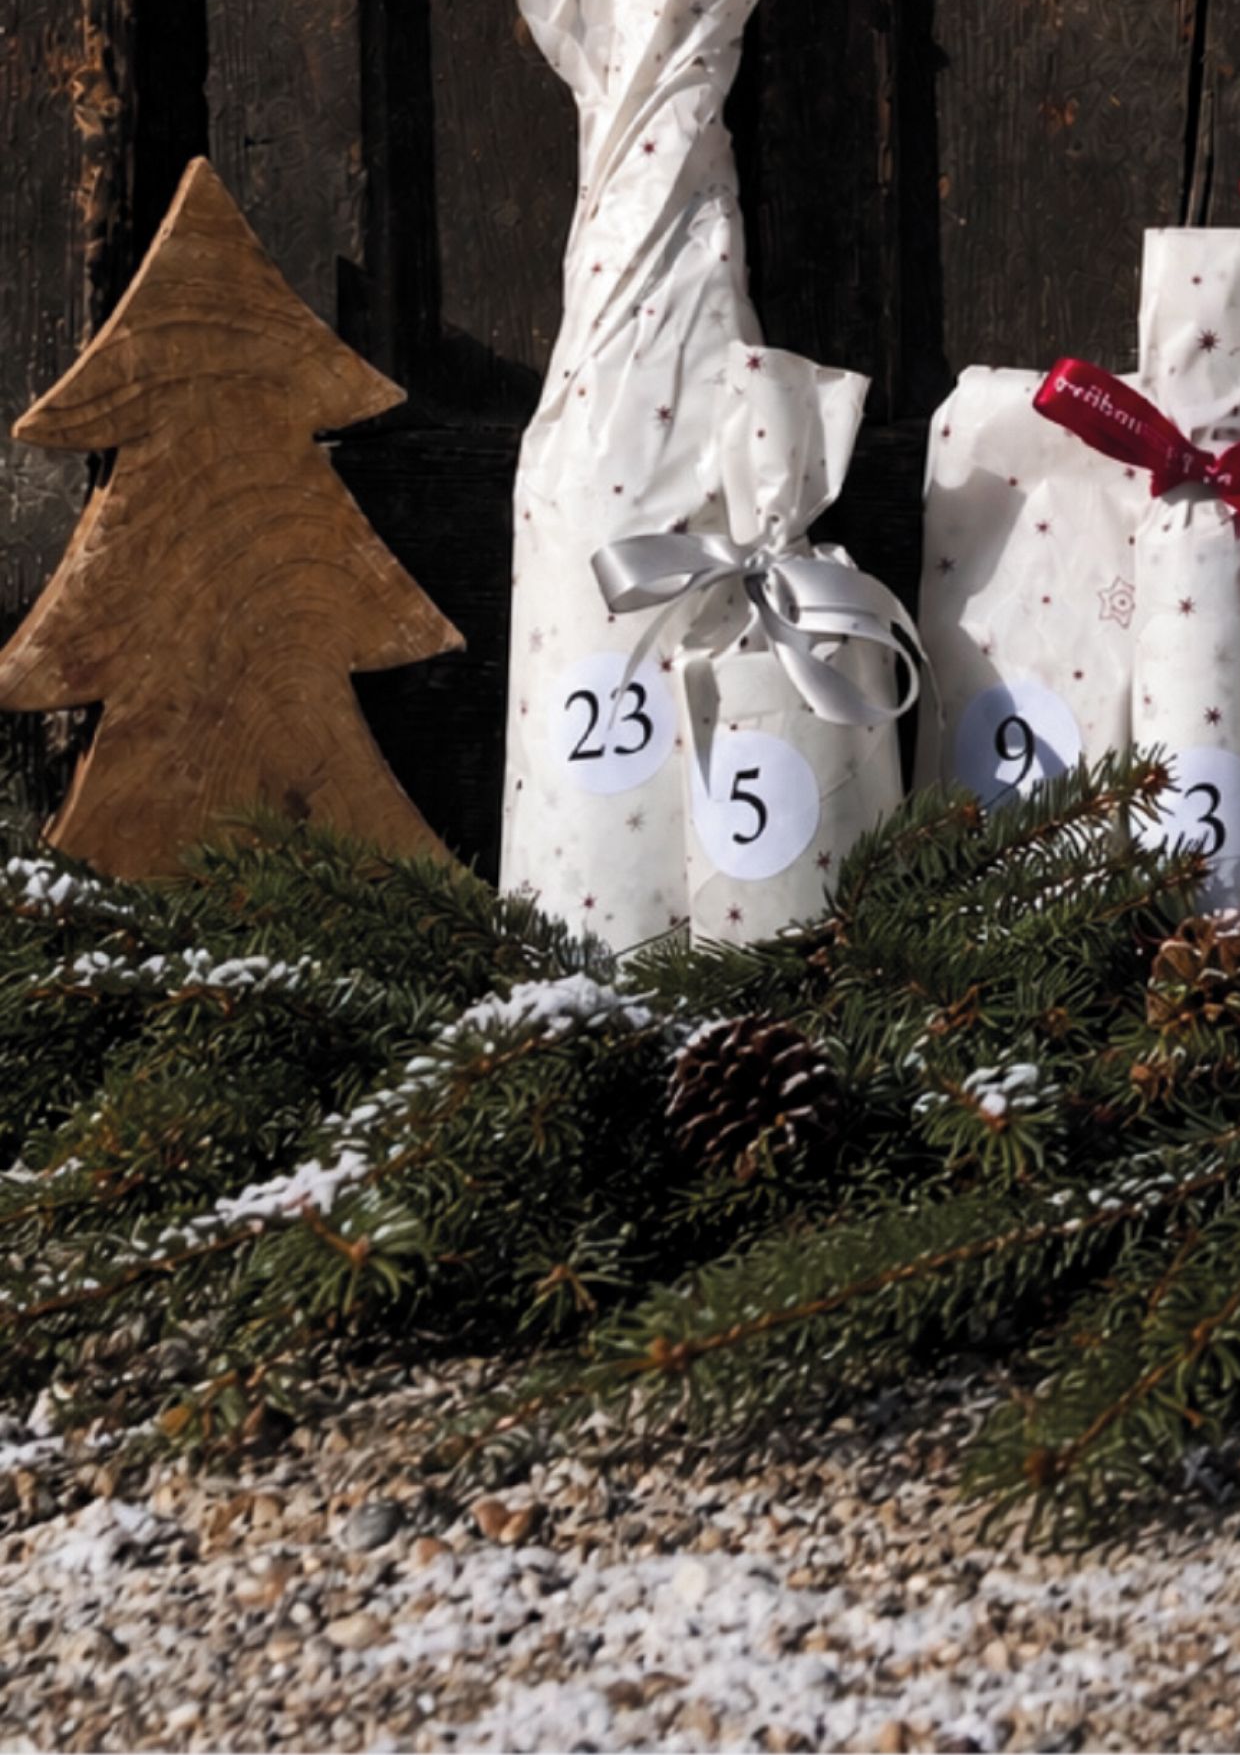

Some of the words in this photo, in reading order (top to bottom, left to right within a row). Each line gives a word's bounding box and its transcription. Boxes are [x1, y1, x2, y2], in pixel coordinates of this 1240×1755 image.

[564, 681, 654, 762] 23
[984, 714, 1036, 808] 9
[728, 767, 768, 845] 5
